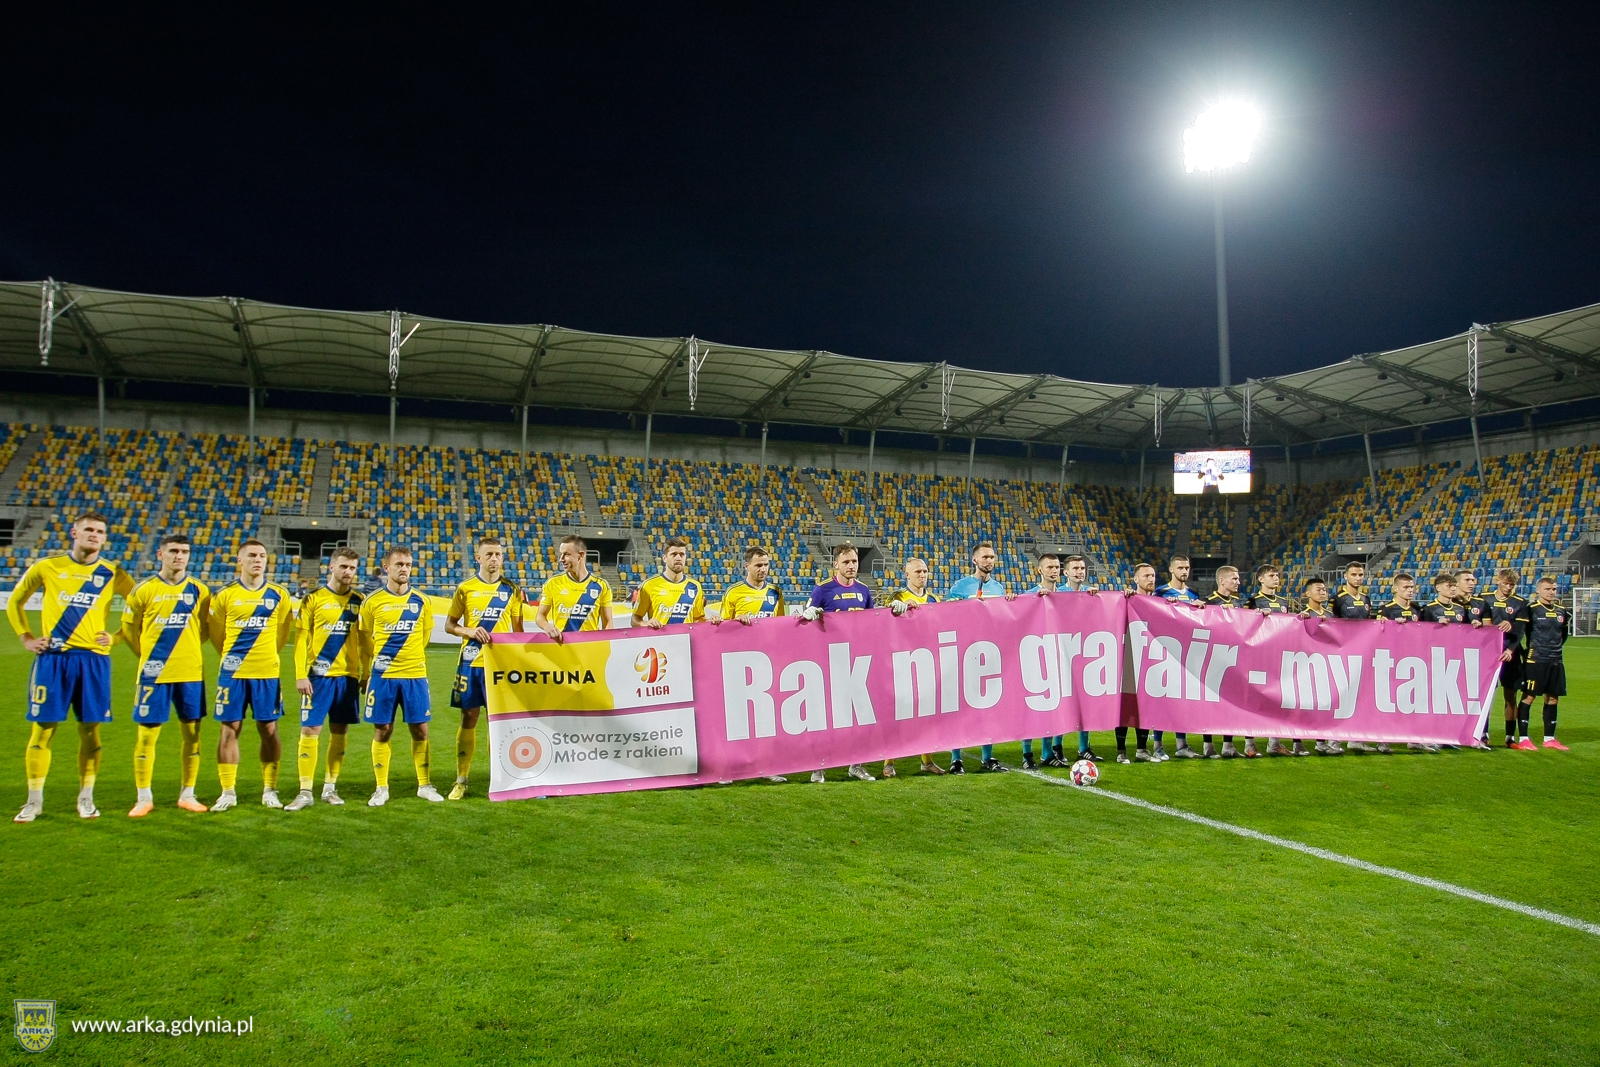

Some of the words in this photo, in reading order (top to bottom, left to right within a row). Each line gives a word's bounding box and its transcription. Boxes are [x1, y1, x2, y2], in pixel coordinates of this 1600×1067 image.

[58, 590, 100, 605] forBET
[472, 607, 506, 618] forBET
[557, 603, 596, 615] forBET
[659, 602, 693, 614] forBET
[154, 613, 192, 625] forBET
[234, 616, 270, 628] forBET
[383, 620, 417, 631] forBET
[493, 670, 596, 685] FORTUNA
[721, 641, 876, 741] Rak
[893, 631, 1003, 721] nie
[1018, 630, 1118, 712] gra
[1122, 620, 1239, 703] fair
[1280, 650, 1363, 719] my
[1372, 646, 1483, 716] tak!
[635, 688, 642, 698] 1
[646, 685, 670, 697] LIGA
[1526, 679, 1536, 691] 11
[142, 686, 154, 704] 7
[214, 686, 230, 704] 21
[367, 690, 376, 706] 6
[552, 725, 684, 746] Stowarzyszenie
[554, 747, 609, 763] Młode
[613, 748, 622, 759] z
[626, 744, 683, 759] rakiem
